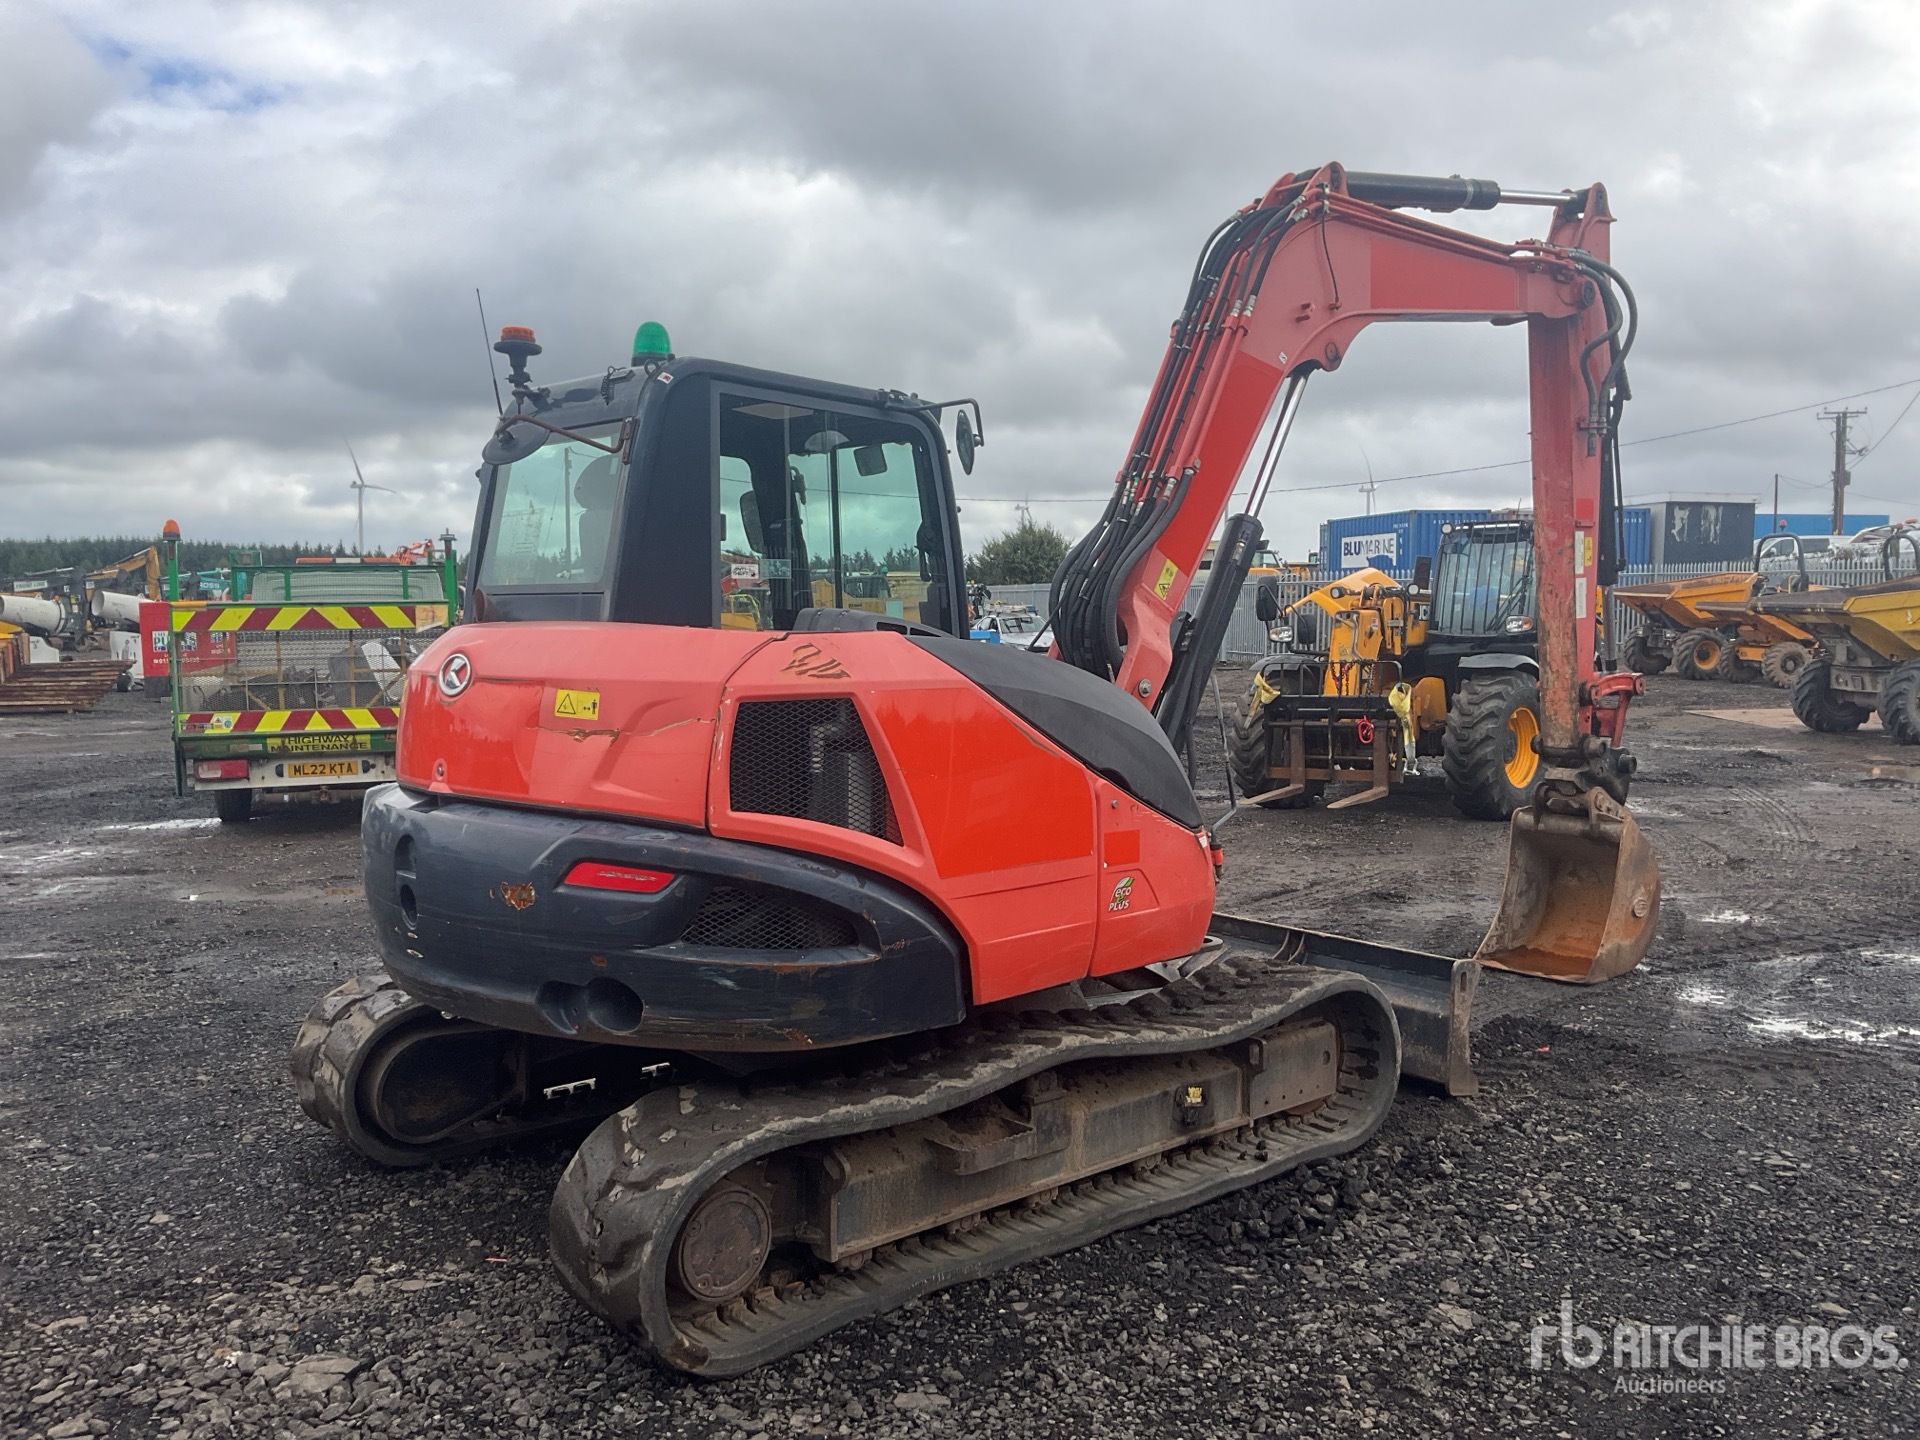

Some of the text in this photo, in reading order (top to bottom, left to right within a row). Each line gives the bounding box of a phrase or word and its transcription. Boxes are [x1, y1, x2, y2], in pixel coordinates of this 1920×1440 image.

[1343, 538, 1394, 556] BLUMARNE
[286, 734, 350, 745] HIGHWAY
[270, 742, 368, 752] MAINTENANCE
[293, 762, 353, 776] ML22 KTA
[1115, 887, 1132, 898] eco
[1108, 900, 1130, 912] PLUS
